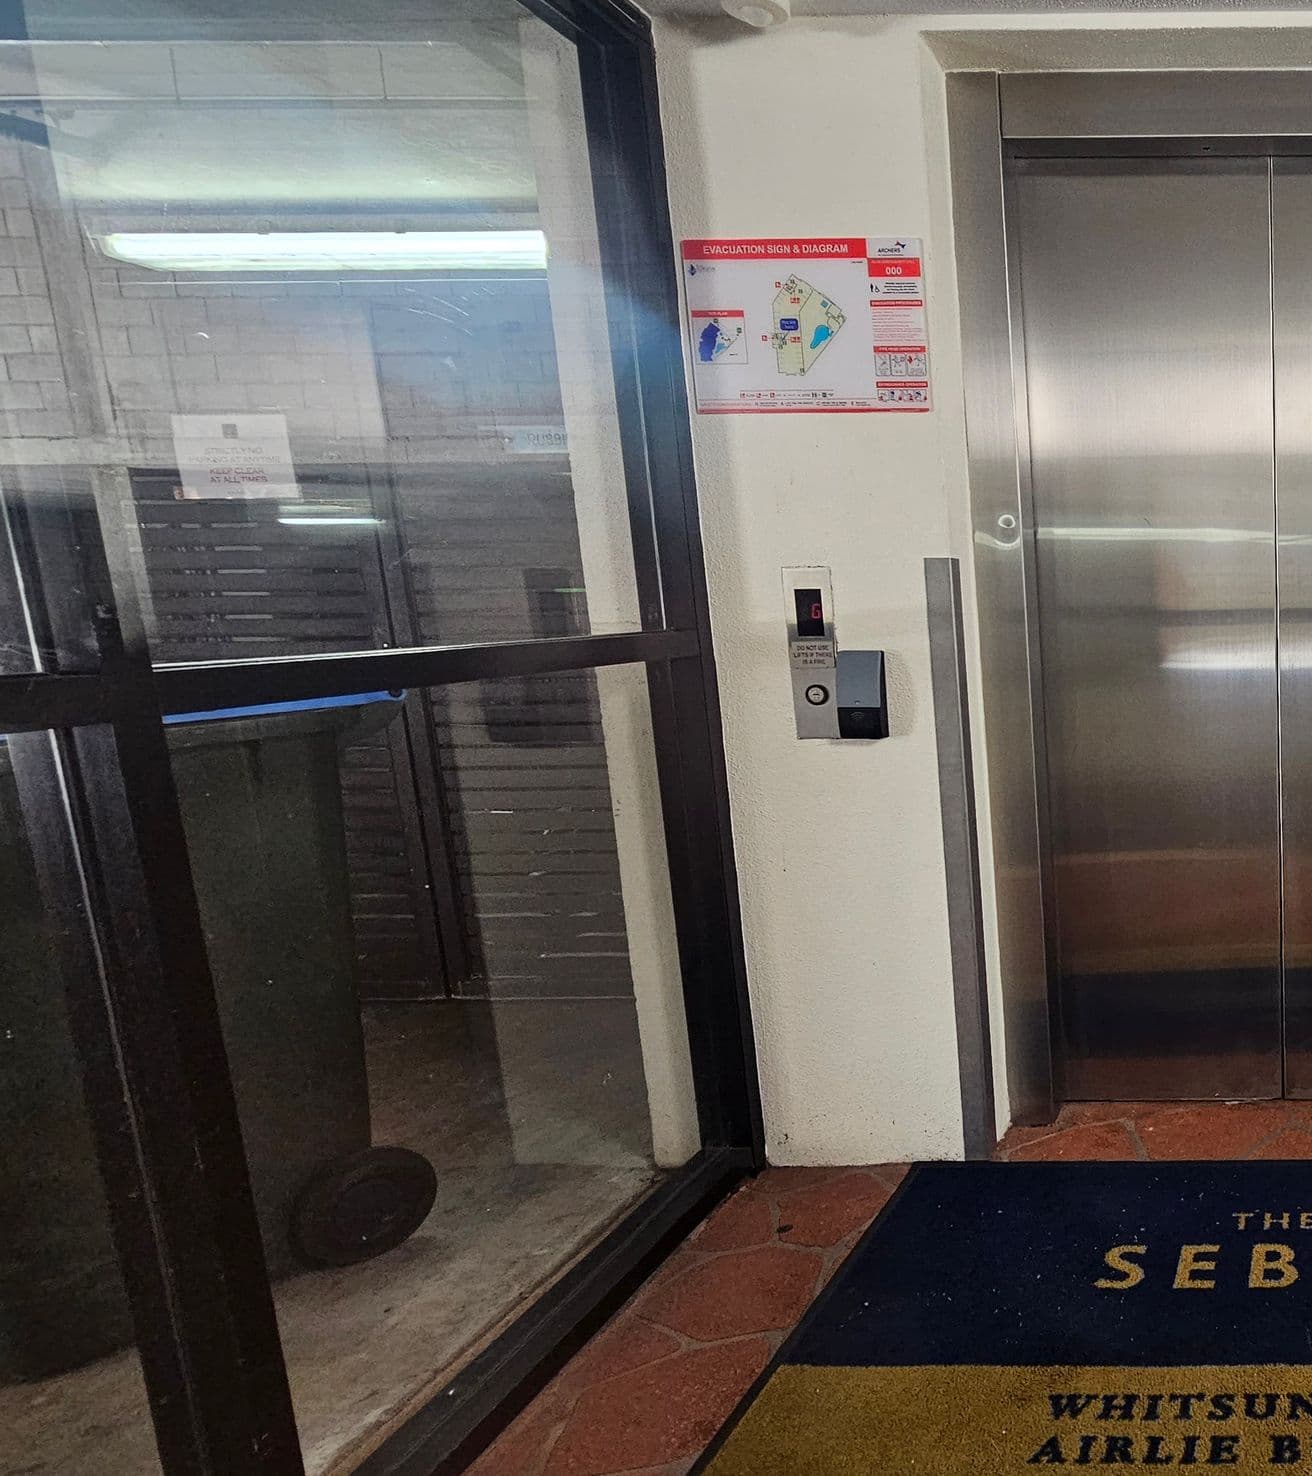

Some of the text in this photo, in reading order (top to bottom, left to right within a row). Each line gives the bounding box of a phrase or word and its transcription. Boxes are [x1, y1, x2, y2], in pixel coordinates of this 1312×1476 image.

[703, 244, 849, 254] EVACUATION SIGN & DIAGRAM
[885, 266, 902, 275] 000
[209, 467, 232, 475] KEEP
[811, 603, 821, 619] G
[1026, 1434, 1241, 1465] AIRLIE
